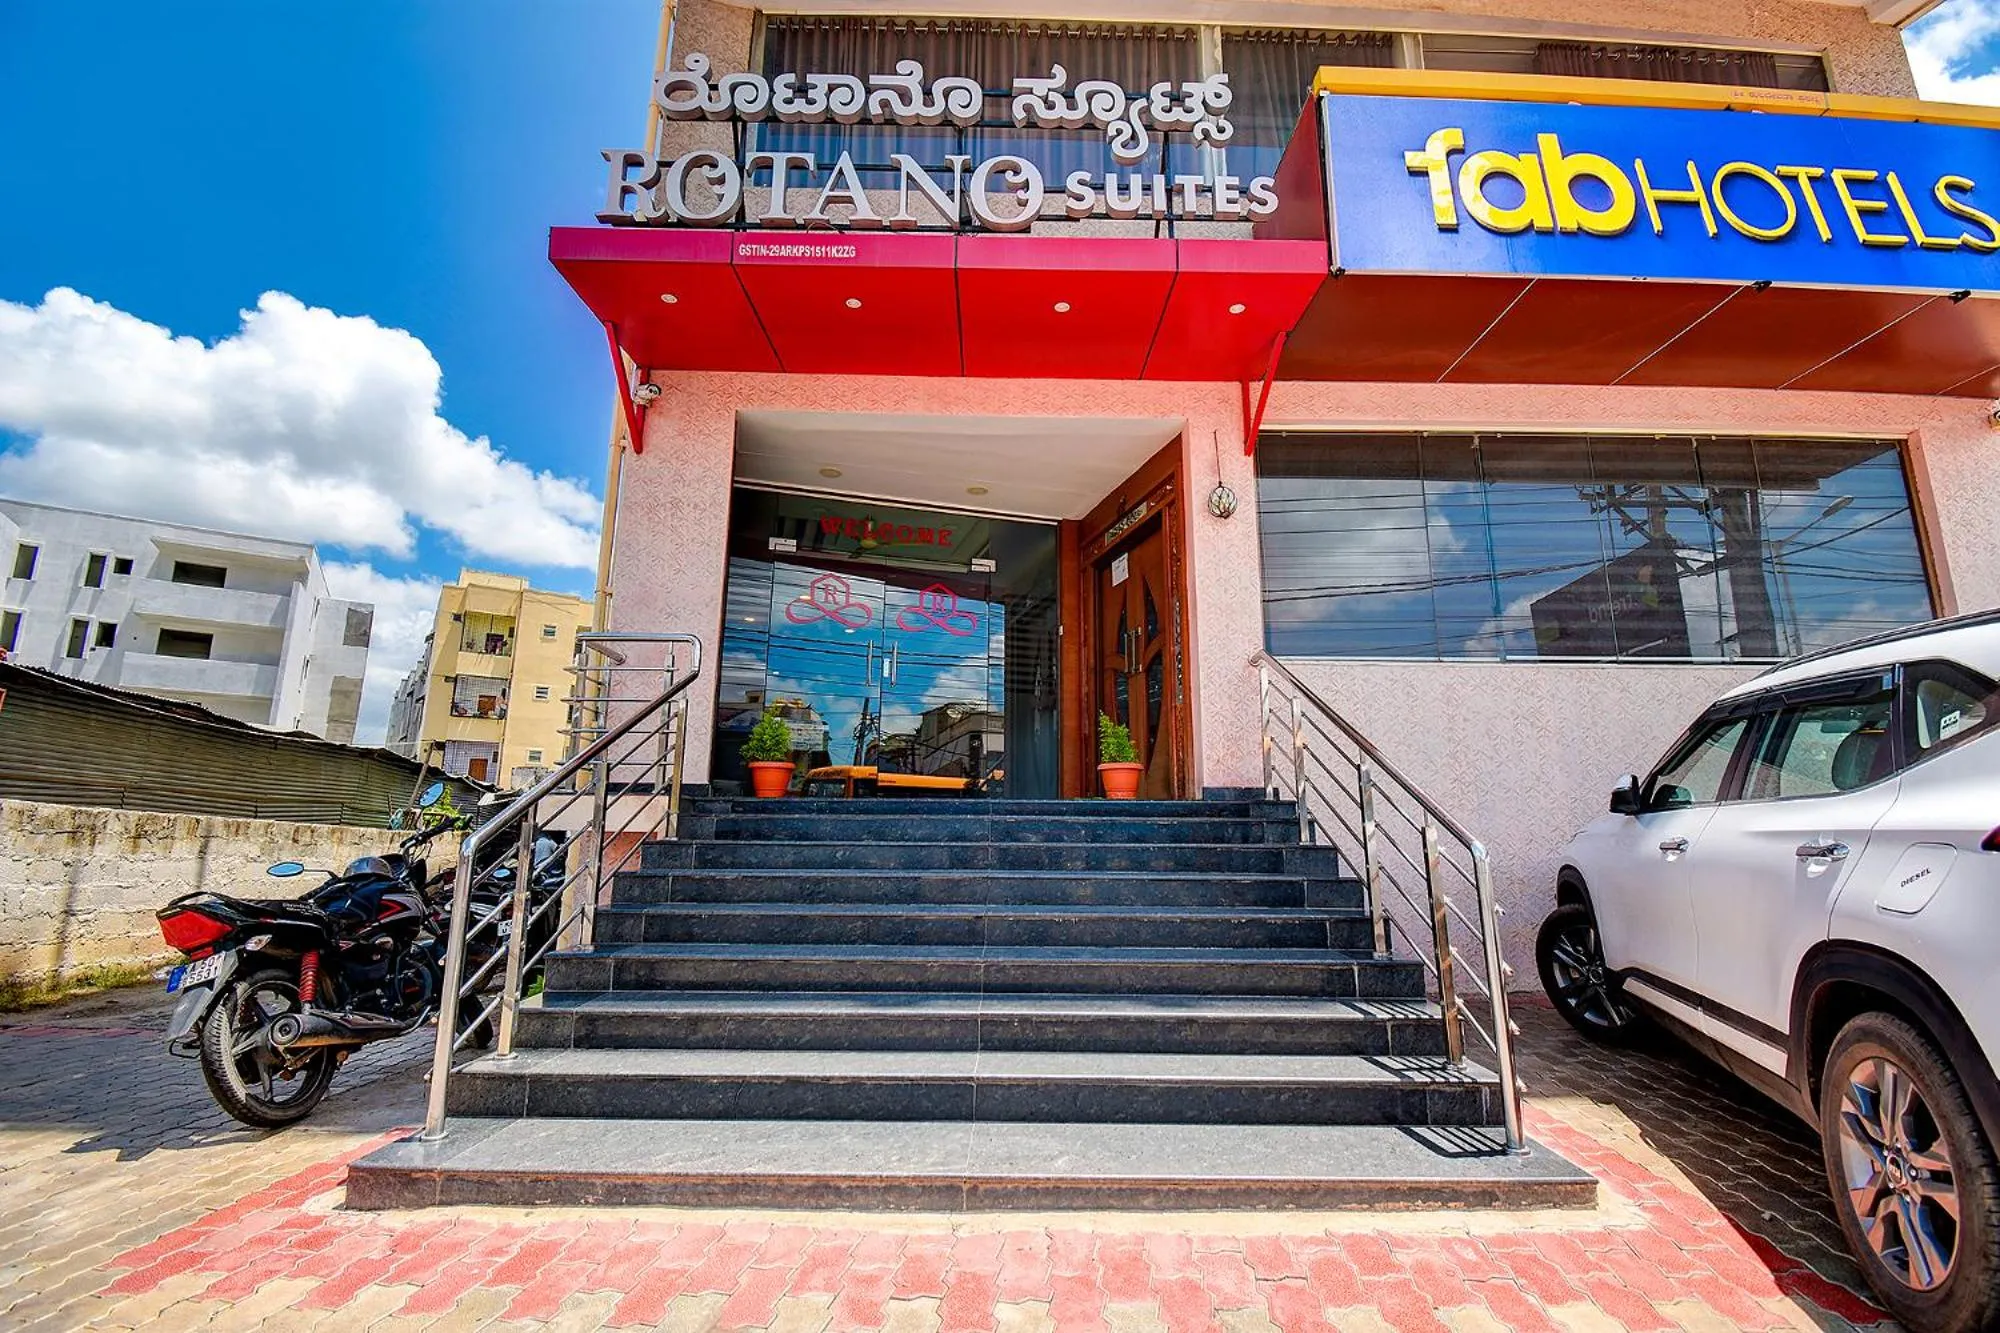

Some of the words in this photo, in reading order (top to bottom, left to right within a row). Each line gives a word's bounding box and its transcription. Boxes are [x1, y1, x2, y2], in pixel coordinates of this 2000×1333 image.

[596, 149, 1045, 232] ROTANO
[1064, 170, 1279, 222] SUITES
[820, 514, 953, 547] WELCOME
[822, 583, 840, 606] R
[931, 594, 947, 614] R
[1900, 867, 1932, 888] DIESEL
